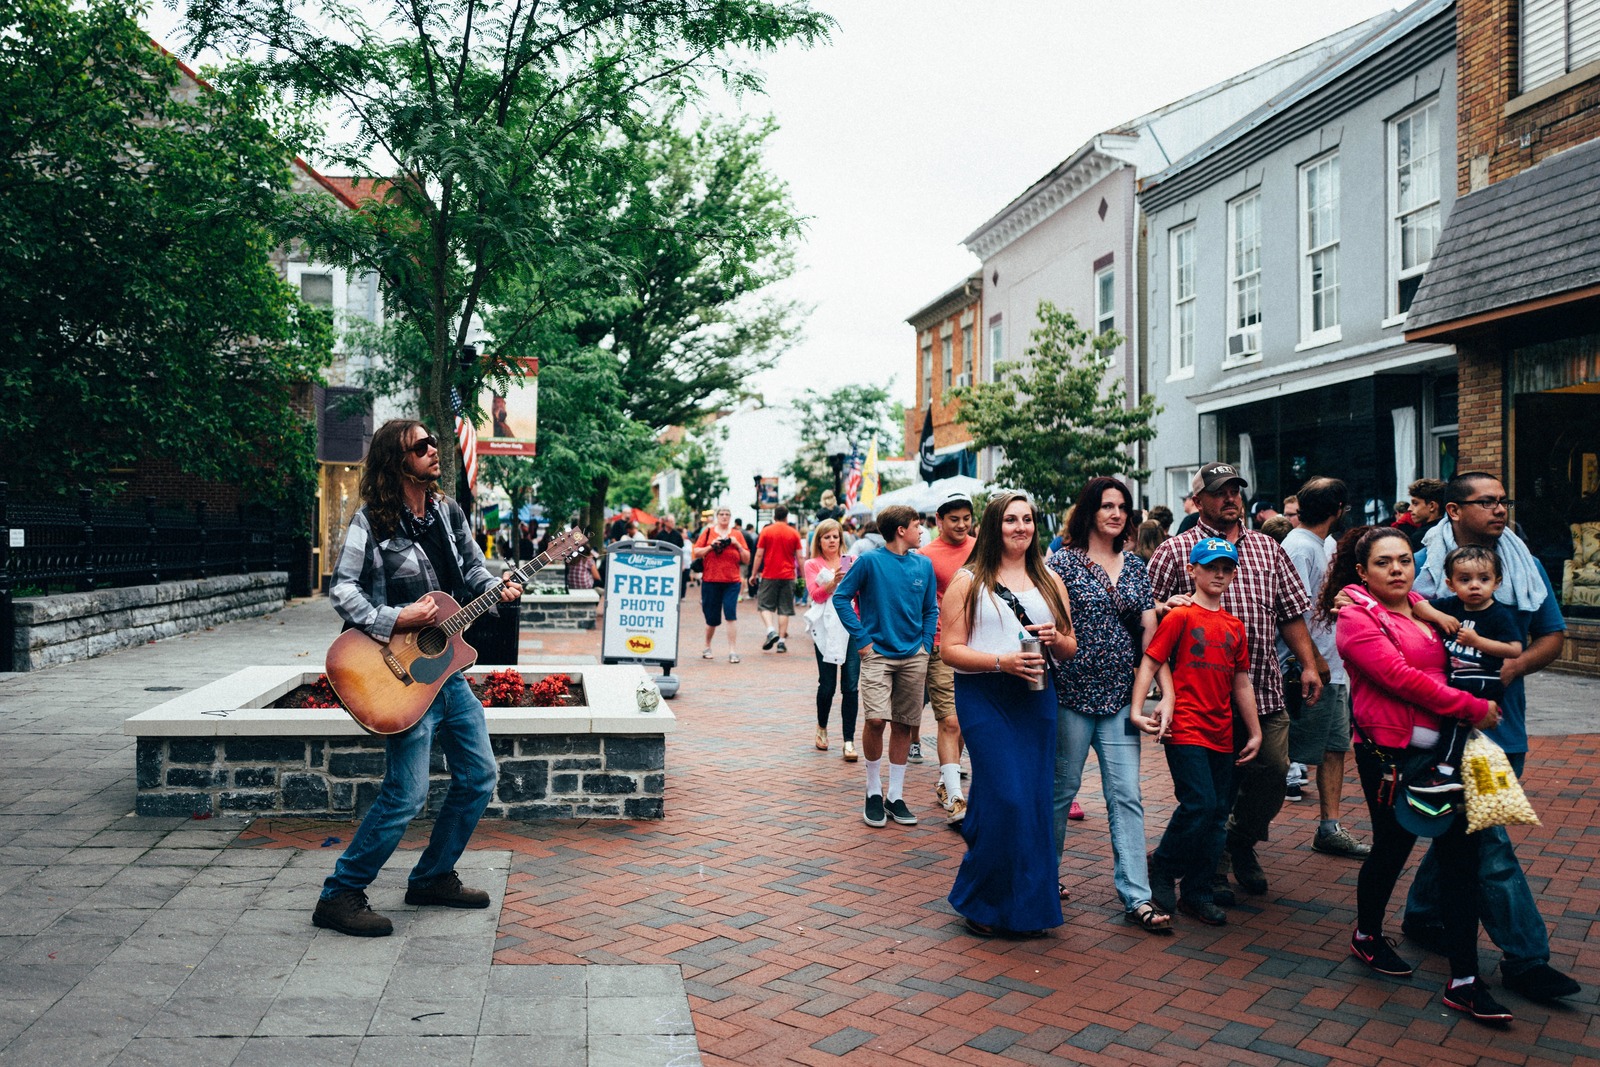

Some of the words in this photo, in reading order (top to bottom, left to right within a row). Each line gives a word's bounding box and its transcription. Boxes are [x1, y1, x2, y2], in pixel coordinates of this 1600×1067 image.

[1210, 466, 1232, 474] YETI
[628, 554, 644, 564] Old
[644, 557, 663, 566] Town
[613, 574, 675, 596] FREE
[620, 599, 665, 612] PHOTO
[619, 614, 664, 628] BOOTH
